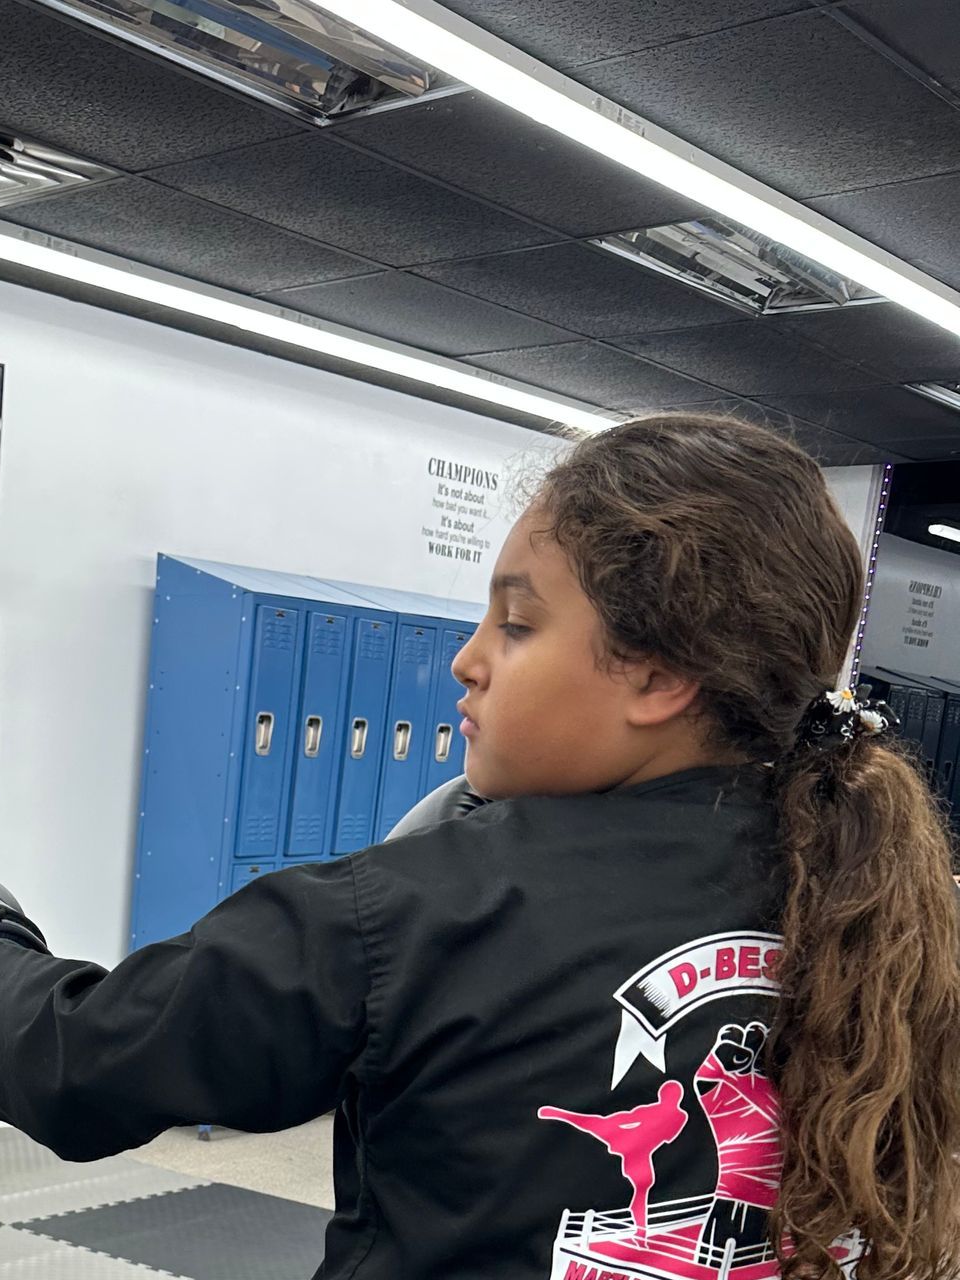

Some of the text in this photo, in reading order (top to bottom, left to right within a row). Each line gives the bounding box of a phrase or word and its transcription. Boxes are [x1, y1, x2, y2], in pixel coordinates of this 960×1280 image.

[428, 457, 499, 491] CHAMPIONS
[437, 483, 485, 505] It's not about
[441, 515, 475, 533] It's about
[428, 541, 483, 563] WORK FOR IT
